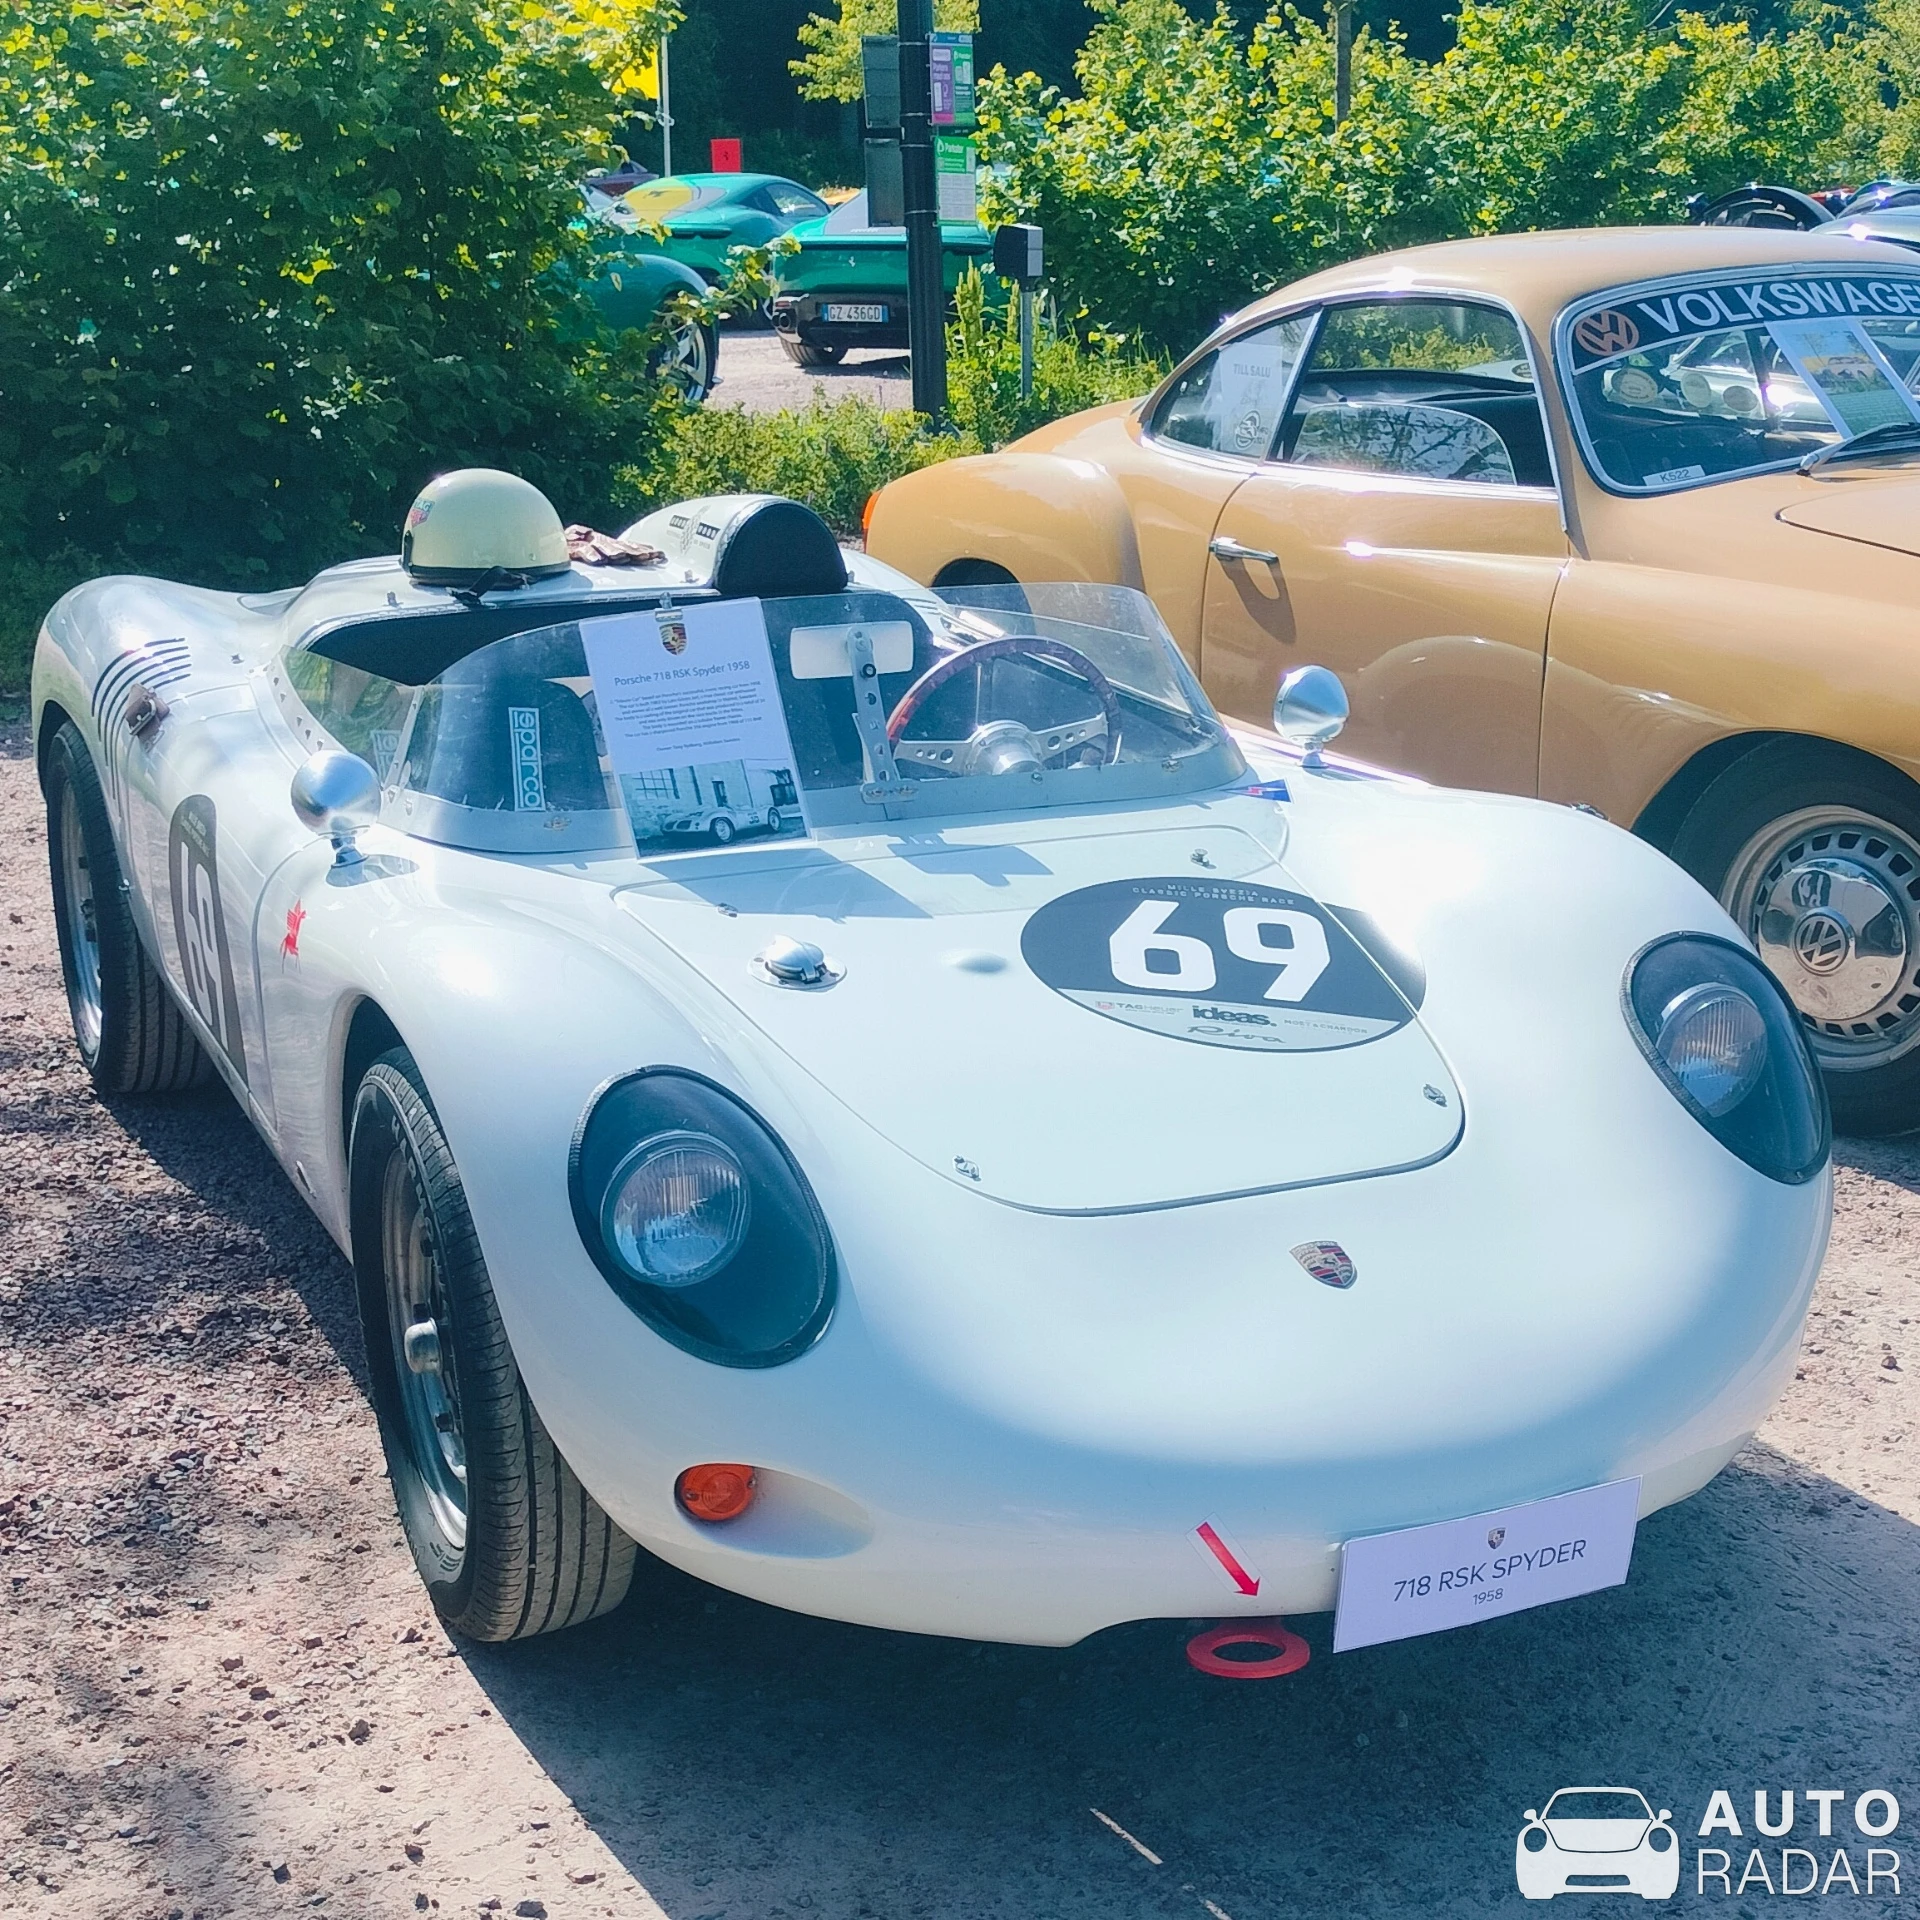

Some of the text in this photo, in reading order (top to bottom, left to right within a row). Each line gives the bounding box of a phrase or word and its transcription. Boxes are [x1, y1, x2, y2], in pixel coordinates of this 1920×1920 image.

[1636, 281, 1920, 334] VOLKSWAGE
[1234, 364, 1271, 378] TILL SALU
[1660, 469, 1691, 482] K522
[614, 660, 750, 686] Porsche 718 RSK Spyder 1958
[513, 710, 541, 809] sparco
[1132, 887, 1295, 905] CLASSIC PORSCHE RACE
[1109, 899, 1330, 1003] 69
[1393, 1539, 1587, 1602] 718 RSK SPYDER
[1472, 1588, 1504, 1606] 1958
